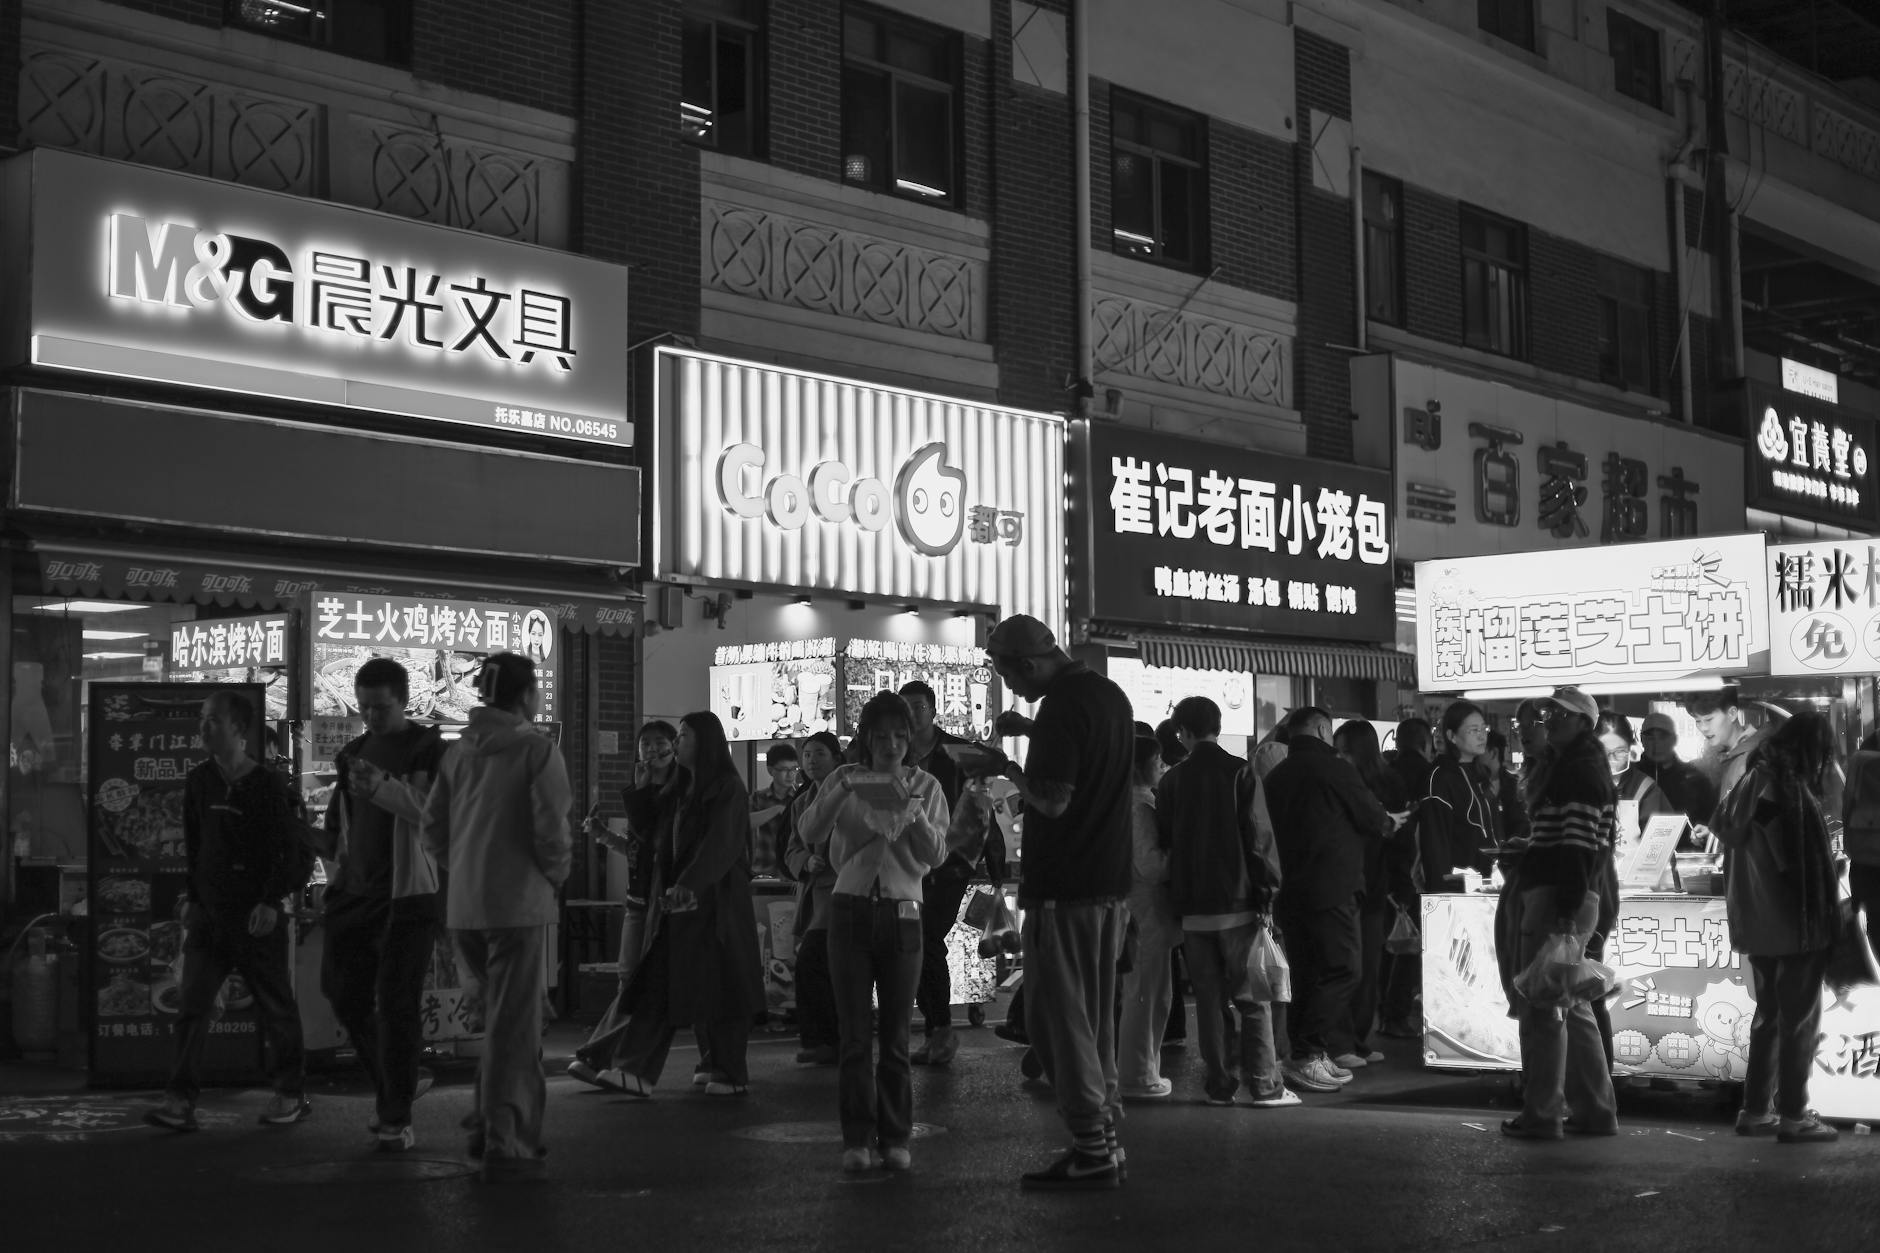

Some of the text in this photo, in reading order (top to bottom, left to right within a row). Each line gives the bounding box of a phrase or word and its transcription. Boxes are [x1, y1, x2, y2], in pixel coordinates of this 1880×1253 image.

[108, 213, 577, 372] M&G 晨光文具
[550, 415, 617, 439] NO.06545
[715, 442, 892, 533] CoCo
[1109, 456, 1390, 565] 崔记老面小笼包
[46, 560, 103, 582] 可口可乐
[125, 567, 181, 588] 可口可乐
[201, 573, 254, 594] 可口可乐
[1247, 576, 1281, 607] 汤包
[317, 597, 510, 649] 芝士火鸡烤冷面
[596, 607, 636, 625] 可口可乐
[1464, 592, 1744, 674] 榴莲芝士饼
[172, 619, 285, 668] 哈尔滨烤冷面
[1800, 618, 1850, 663] 免
[134, 757, 210, 781] 新品上
